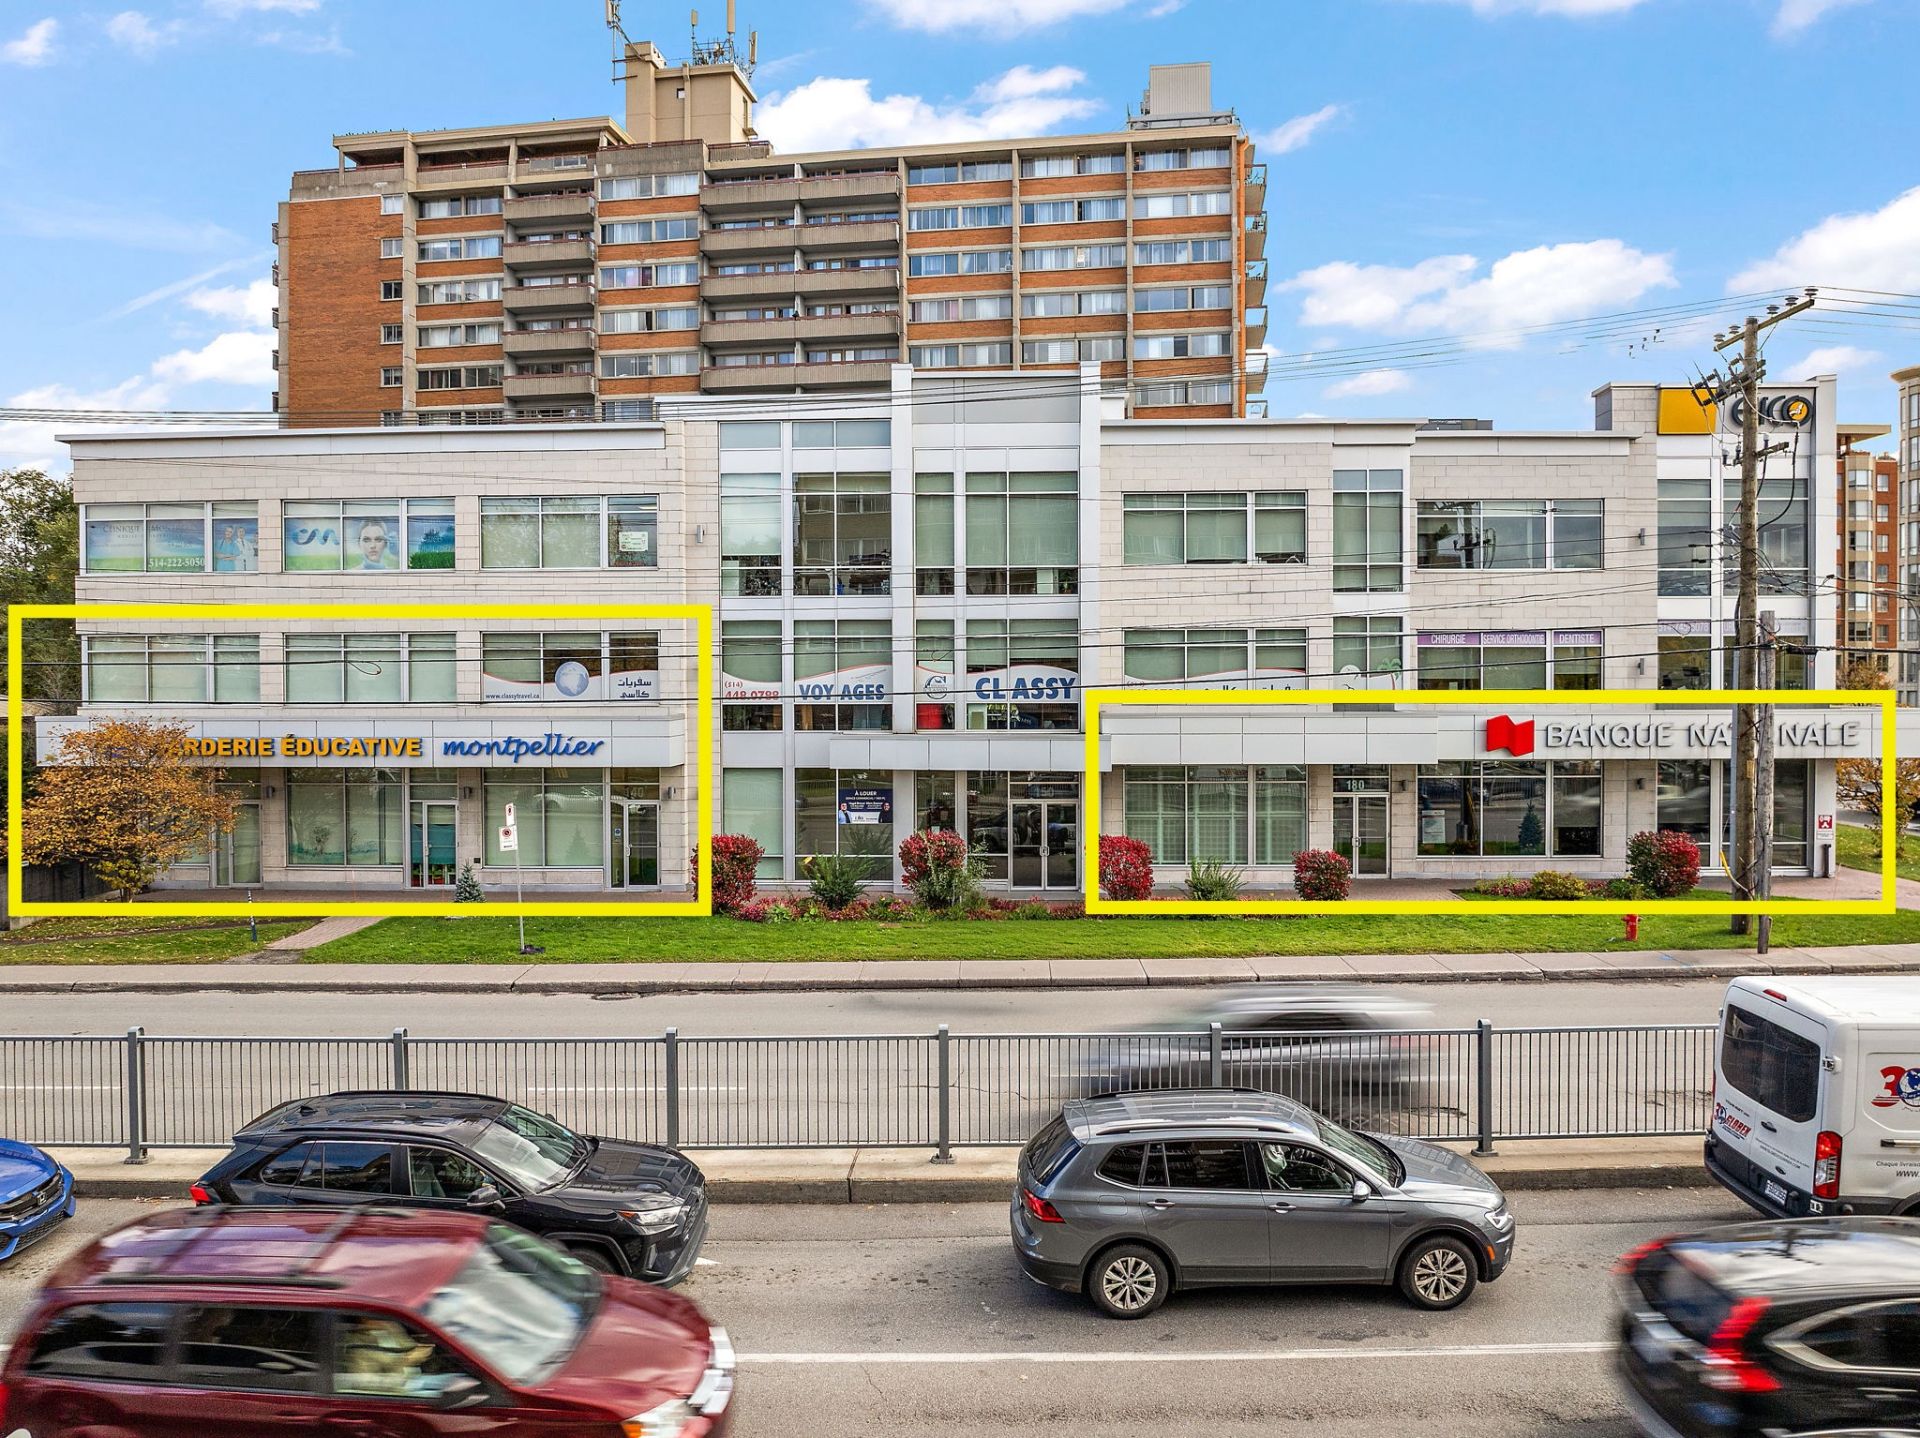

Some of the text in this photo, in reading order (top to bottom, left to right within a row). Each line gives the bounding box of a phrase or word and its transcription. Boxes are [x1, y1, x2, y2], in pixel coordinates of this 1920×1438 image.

[149, 557, 205, 568] 514-222-5050
[1431, 633, 1467, 644] CHIRURGIE
[1483, 634, 1545, 645] SERVICE ORTHODONTIE
[1559, 633, 1595, 644] DENTISTE
[485, 692, 540, 700] www.classytravel.ca
[1546, 721, 1860, 748] BANQUE NANALE
[183, 733, 605, 763] RDERIE ÉDUCATIVE montpellier
[1346, 779, 1365, 791] 180
